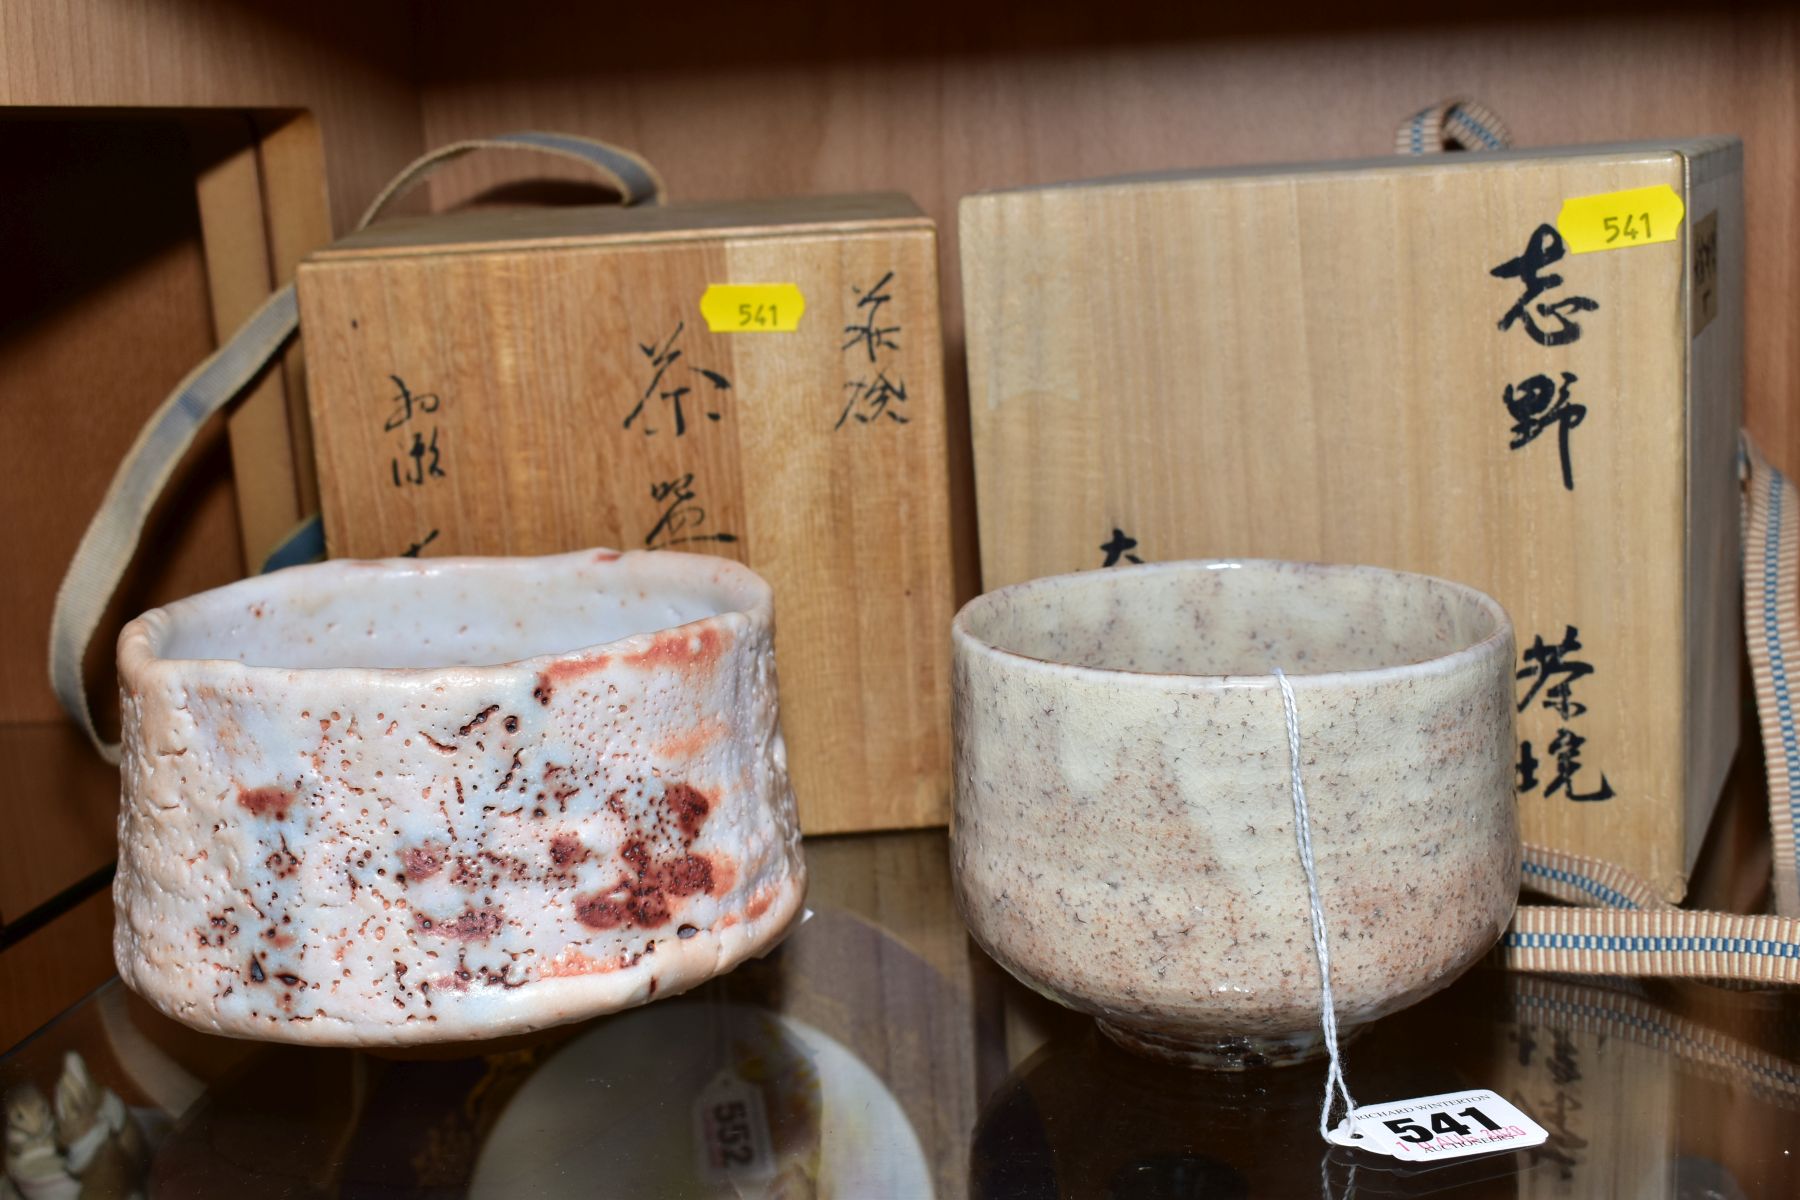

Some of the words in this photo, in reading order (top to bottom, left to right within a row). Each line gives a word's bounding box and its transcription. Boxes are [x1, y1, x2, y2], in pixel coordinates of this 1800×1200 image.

[1603, 212, 1652, 244] 541
[738, 303, 778, 327] 541
[1355, 1106, 1414, 1121] RICHARD
[1415, 1093, 1491, 1111] WINTERTON
[1382, 1106, 1502, 1143] 541
[1424, 1134, 1515, 1154] AUCTIONEERS
